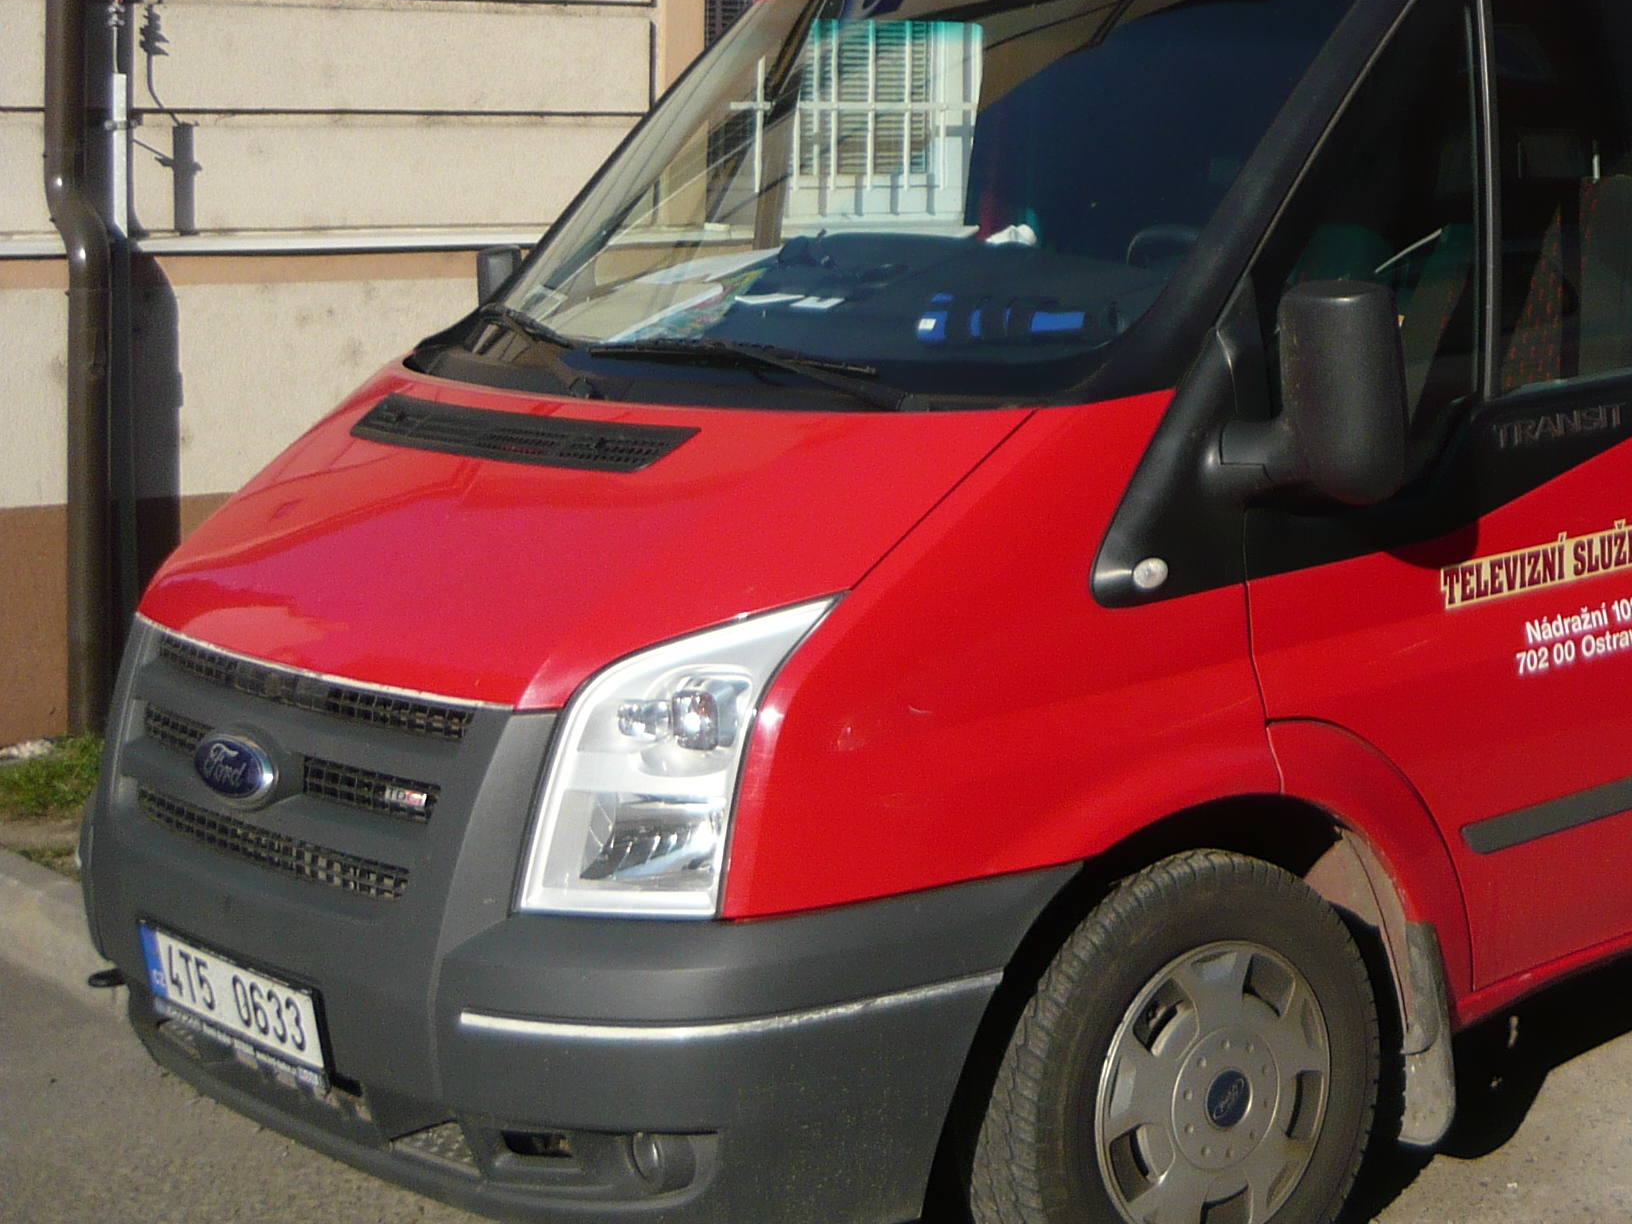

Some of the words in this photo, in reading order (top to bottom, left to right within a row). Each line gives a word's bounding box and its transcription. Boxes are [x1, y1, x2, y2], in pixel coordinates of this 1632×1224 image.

[1493, 401, 1626, 448] TRANSIT
[1444, 533, 1567, 605] TELEVIZNÍ
[1525, 601, 1608, 643] Nádražní
[1516, 647, 1549, 675] 702
[1553, 640, 1576, 664] 00
[204, 742, 248, 788] Ford
[168, 945, 216, 1011] 4T5
[232, 974, 306, 1052] 0633
